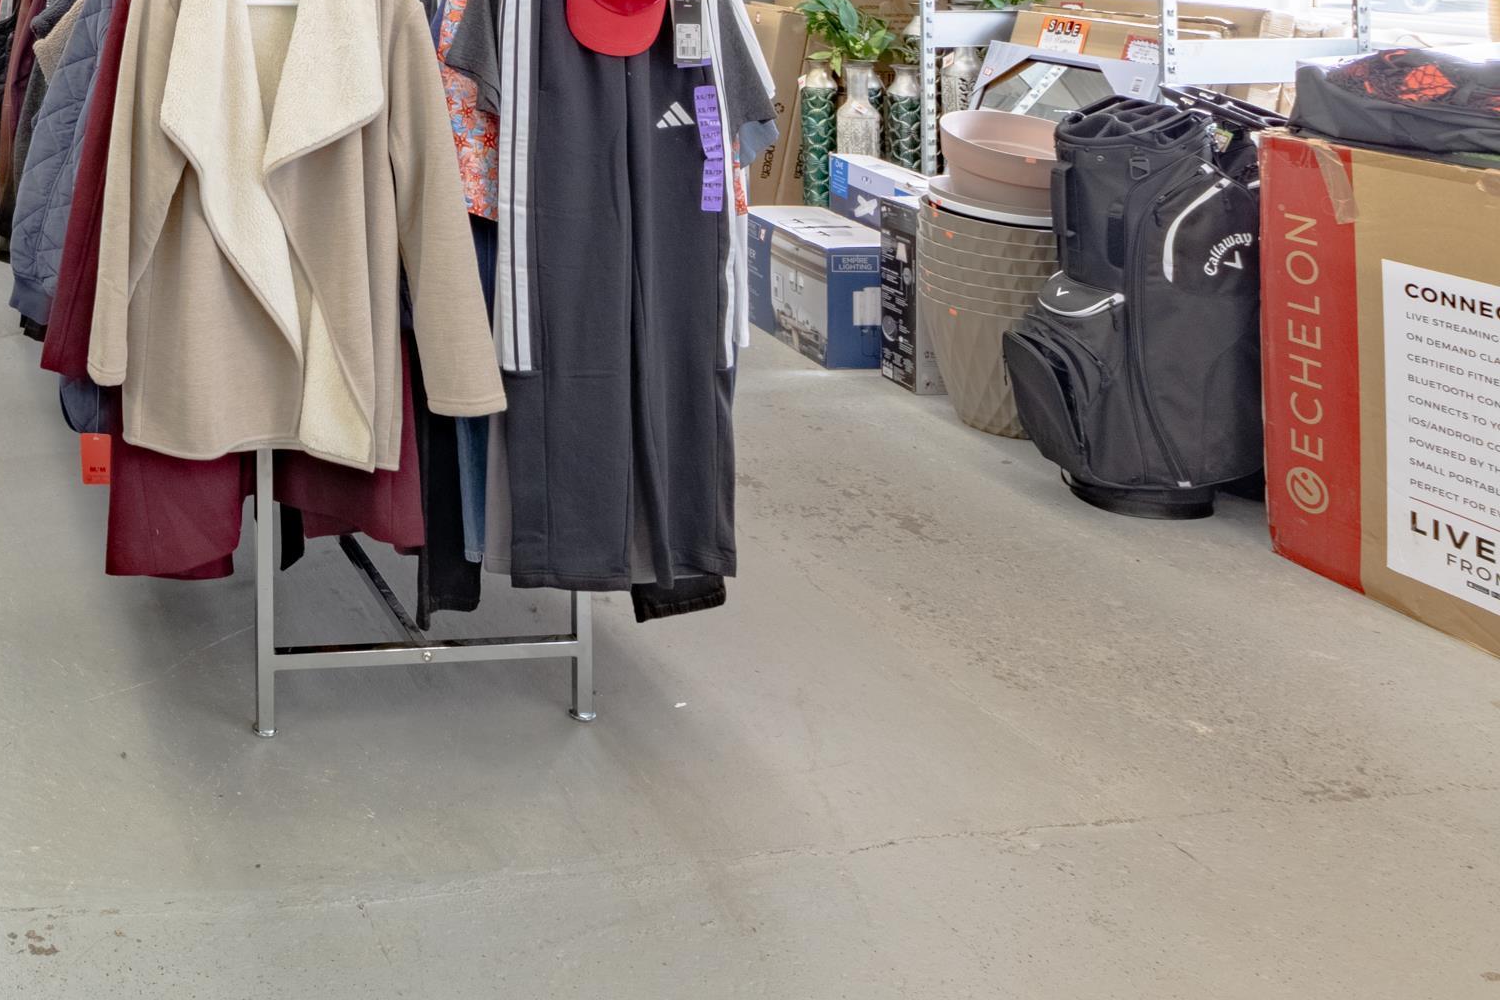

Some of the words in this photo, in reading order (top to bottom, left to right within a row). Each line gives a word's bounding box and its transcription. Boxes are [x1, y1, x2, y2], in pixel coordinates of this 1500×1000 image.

[1048, 19, 1082, 37] SALE
[1204, 232, 1252, 276] Callaway
[1406, 311, 1429, 324] LIVE
[1284, 212, 1323, 462] ECHELON
[1406, 332, 1423, 343] ON
[1426, 337, 1477, 358] DEMAND
[1407, 353, 1465, 376] CERTIFIED
[1407, 374, 1474, 400] BLUETOOTH
[1408, 395, 1469, 420] CONNECTS
[1472, 415, 1487, 426] TO
[1408, 415, 1484, 446] iOS/ANDROID
[1409, 436, 1466, 462] POWERED
[1469, 457, 1485, 468] BY
[1409, 457, 1445, 477] SMALL
[1449, 471, 1500, 497] PORTABL
[1410, 478, 1459, 502] PERFECT
[1463, 497, 1486, 512] FOR
[1410, 510, 1496, 564] LIVE
